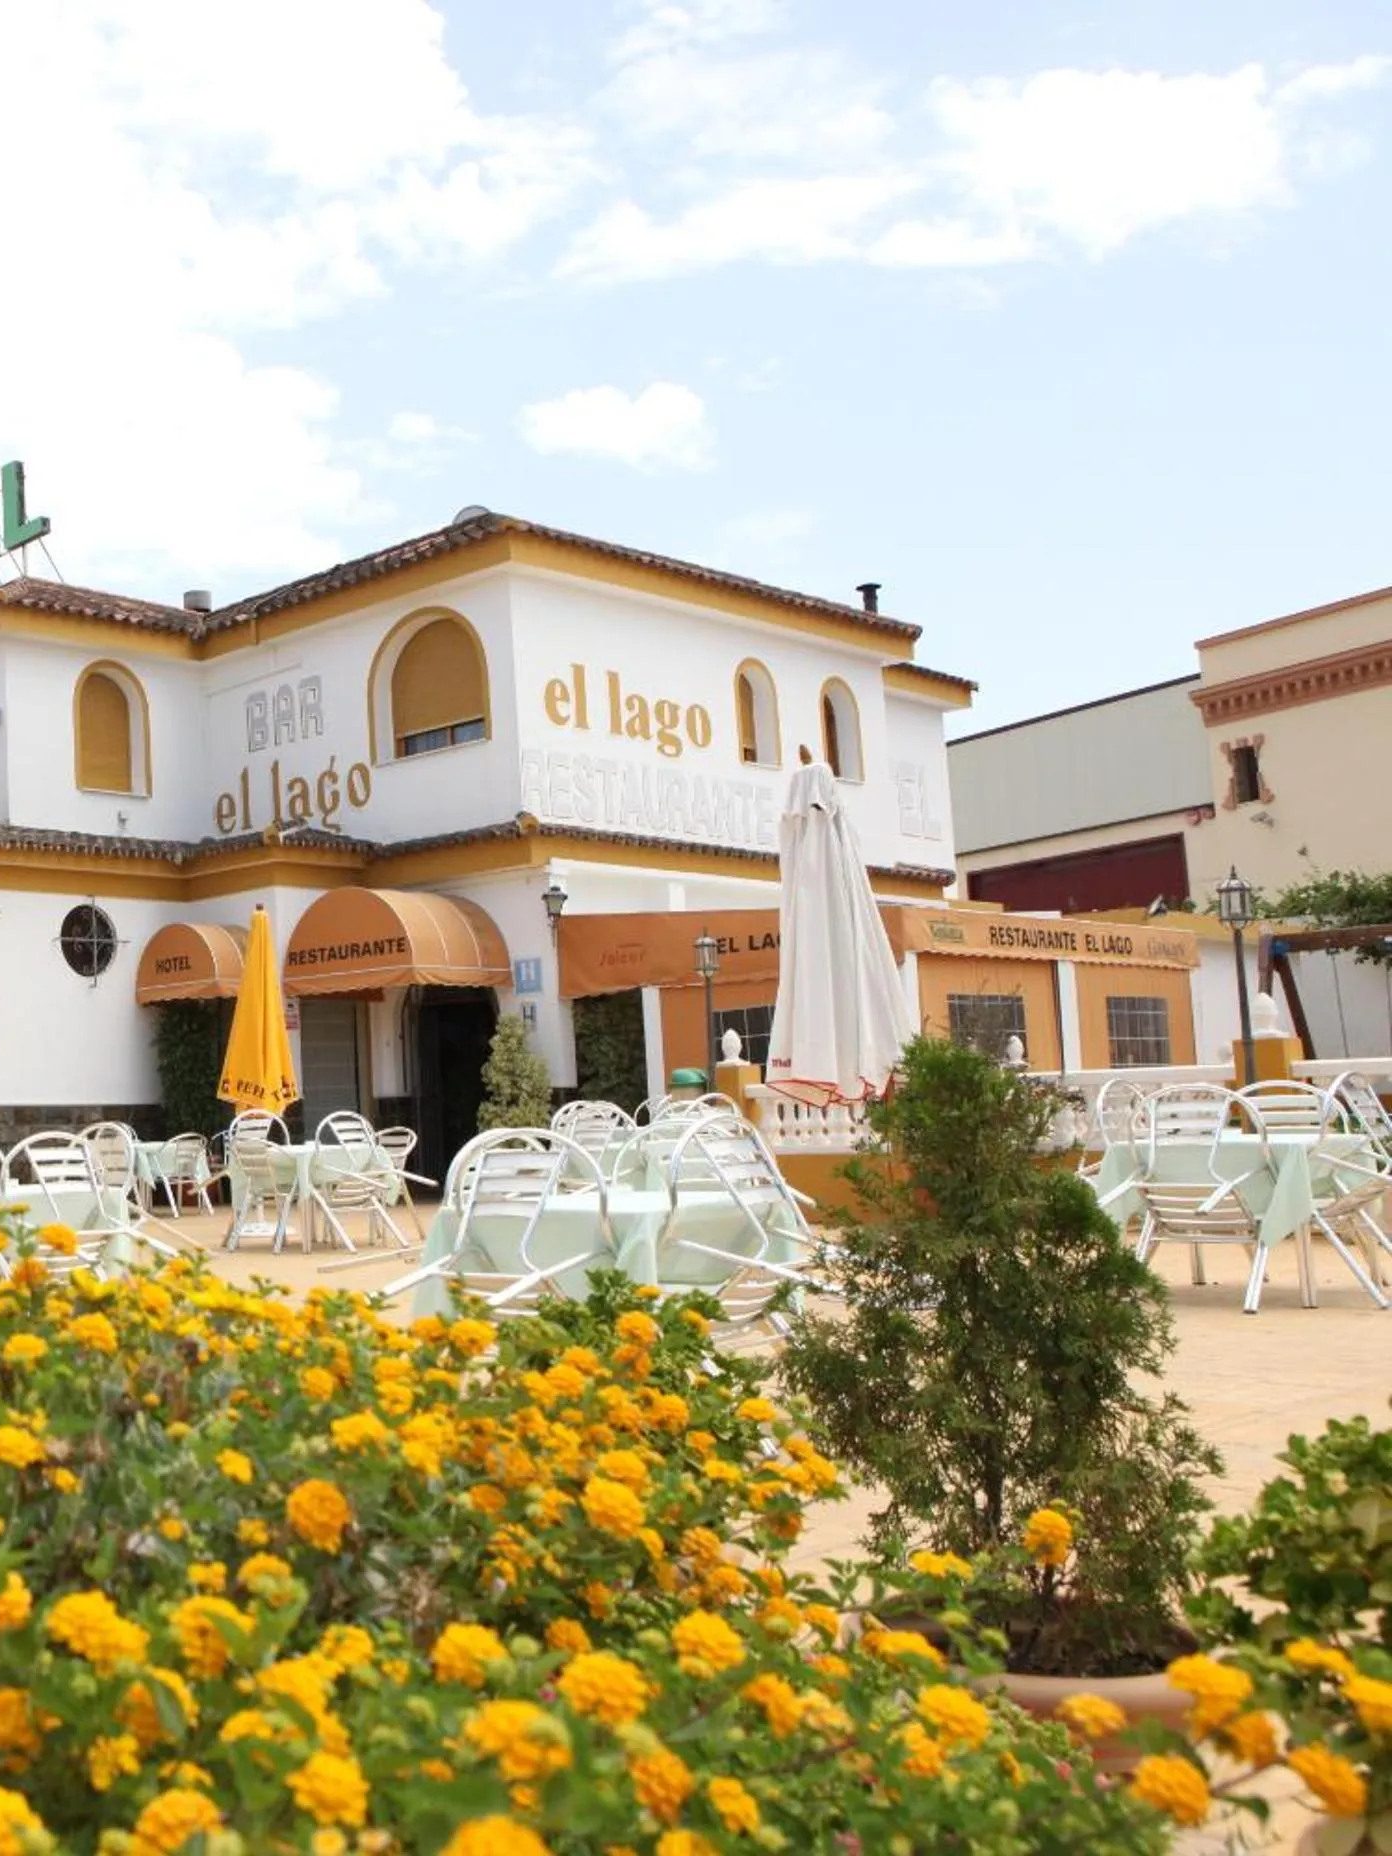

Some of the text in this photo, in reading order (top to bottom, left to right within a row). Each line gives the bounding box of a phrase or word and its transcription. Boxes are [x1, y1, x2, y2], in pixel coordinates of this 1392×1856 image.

[245, 675, 324, 753] BAR
[543, 663, 712, 758] el lago
[215, 765, 253, 834] el
[521, 750, 775, 843] RESTAURANTE
[288, 936, 407, 967] RESTAURANTE
[749, 931, 780, 952] LA
[989, 925, 1078, 952] RESTAURANTE
[1084, 933, 1100, 953] EL
[1102, 934, 1134, 955] LAGO
[155, 955, 193, 976] HOTEL
